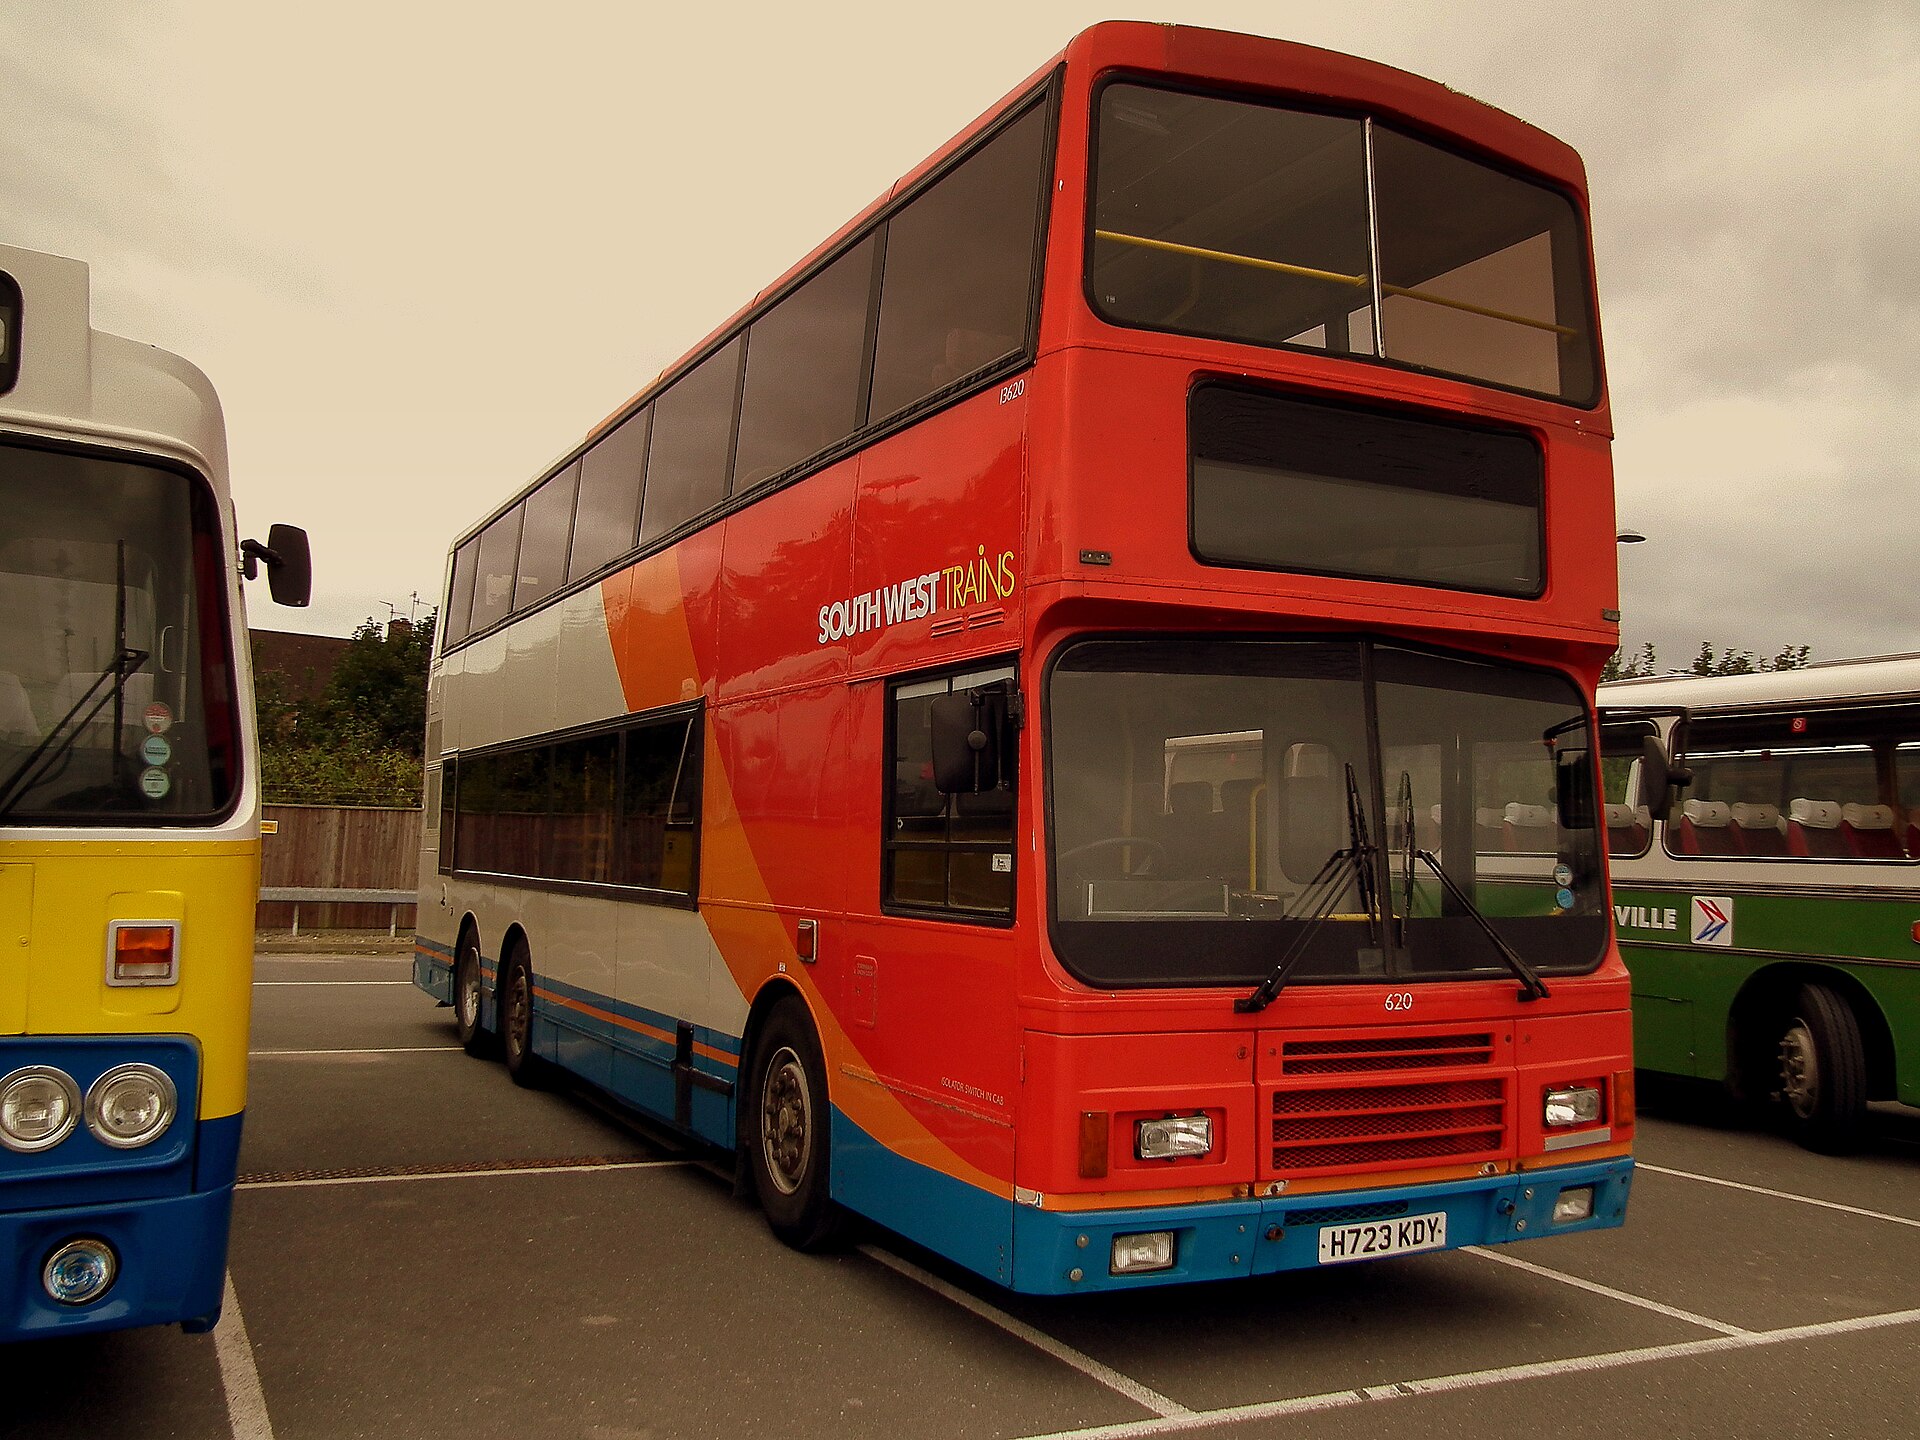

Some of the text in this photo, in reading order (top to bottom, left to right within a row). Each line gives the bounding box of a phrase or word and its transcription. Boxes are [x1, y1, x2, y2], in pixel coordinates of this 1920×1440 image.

[999, 378, 1025, 406] 13620
[818, 588, 881, 645] SOUTH
[883, 571, 941, 626] WEST
[1613, 905, 1677, 930] VILLE
[1384, 992, 1413, 1011] 620
[965, 1084, 985, 1099] SWITCH
[985, 1091, 992, 1102] IN
[992, 1093, 1004, 1106] CAB
[1330, 1216, 1439, 1257] H723 KDY
